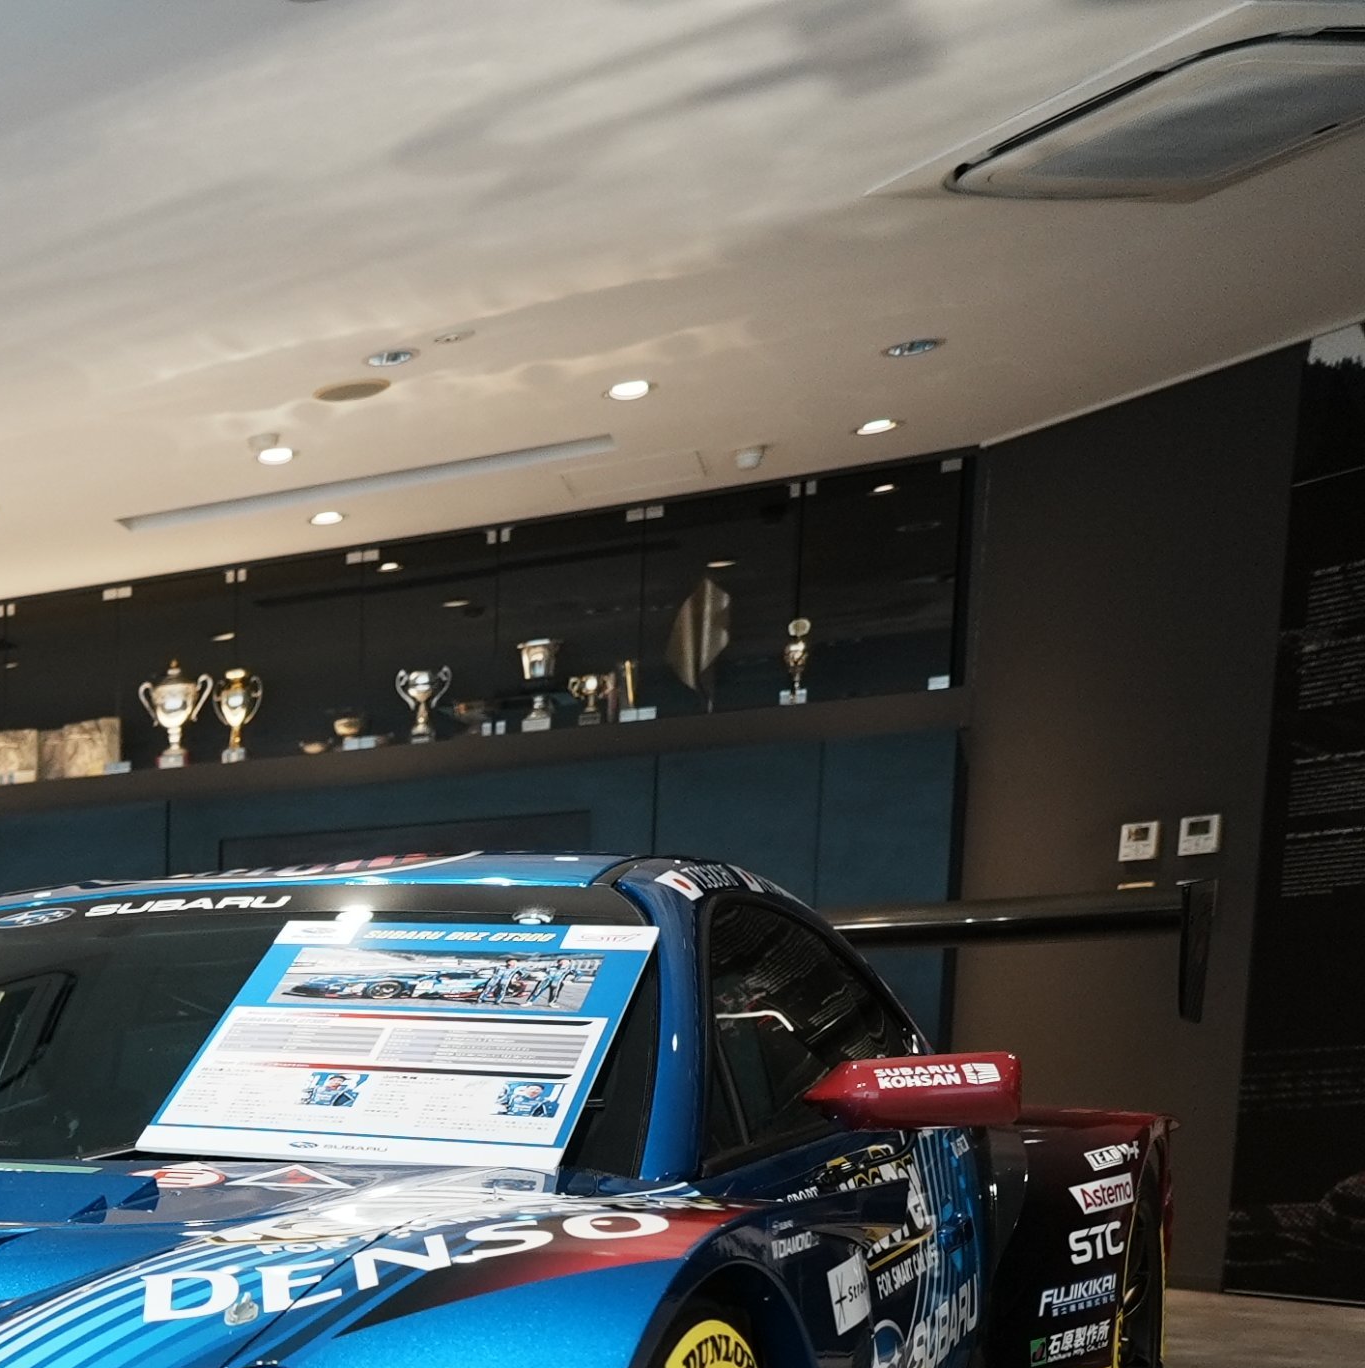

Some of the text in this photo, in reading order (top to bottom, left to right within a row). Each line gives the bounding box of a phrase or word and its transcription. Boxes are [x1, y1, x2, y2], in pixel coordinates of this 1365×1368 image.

[85, 895, 291, 918] SUBARU
[873, 1064, 956, 1079] SUBARU
[878, 1073, 961, 1089] KOHSAN
[1081, 1181, 1132, 1211] Astemo
[1069, 1221, 1124, 1265] STC
[143, 1211, 669, 1324] DENSO
[1038, 1273, 1117, 1317] FUJIKIKAI
